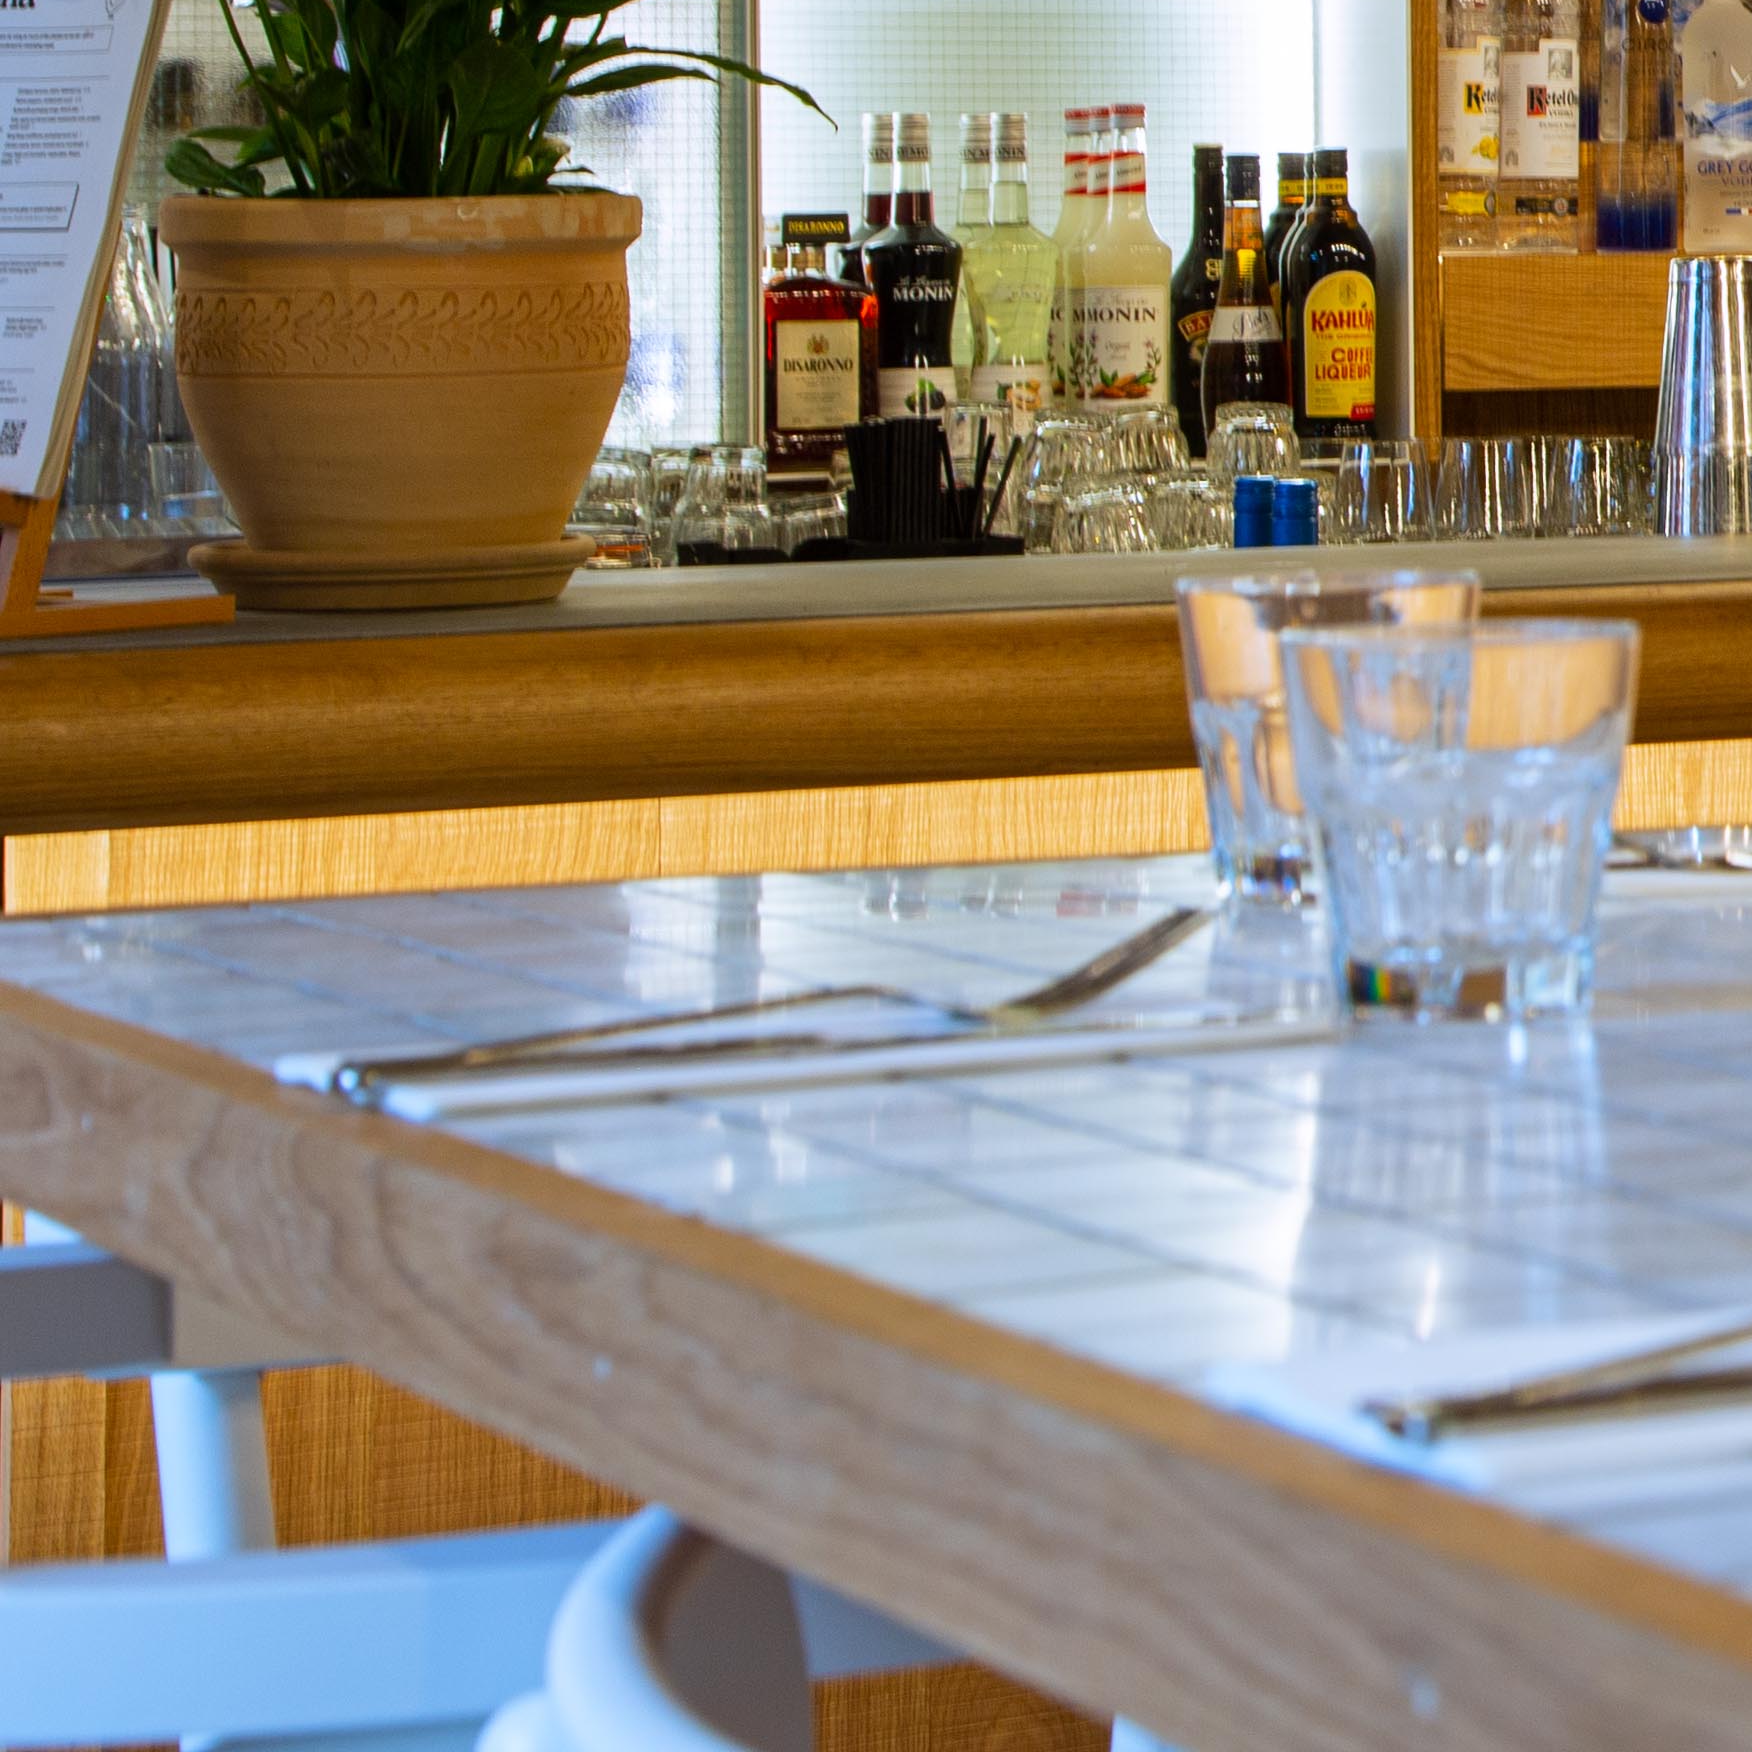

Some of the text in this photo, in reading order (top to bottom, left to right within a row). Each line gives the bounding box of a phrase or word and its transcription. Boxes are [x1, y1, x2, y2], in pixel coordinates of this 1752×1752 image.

[1528, 86, 1566, 112] Ketel
[1697, 159, 1733, 177] GREY
[787, 219, 844, 235] DISARONNO
[892, 286, 954, 301] MONIN
[1086, 306, 1157, 322] MONIN
[783, 355, 854, 373] DISARONNO
